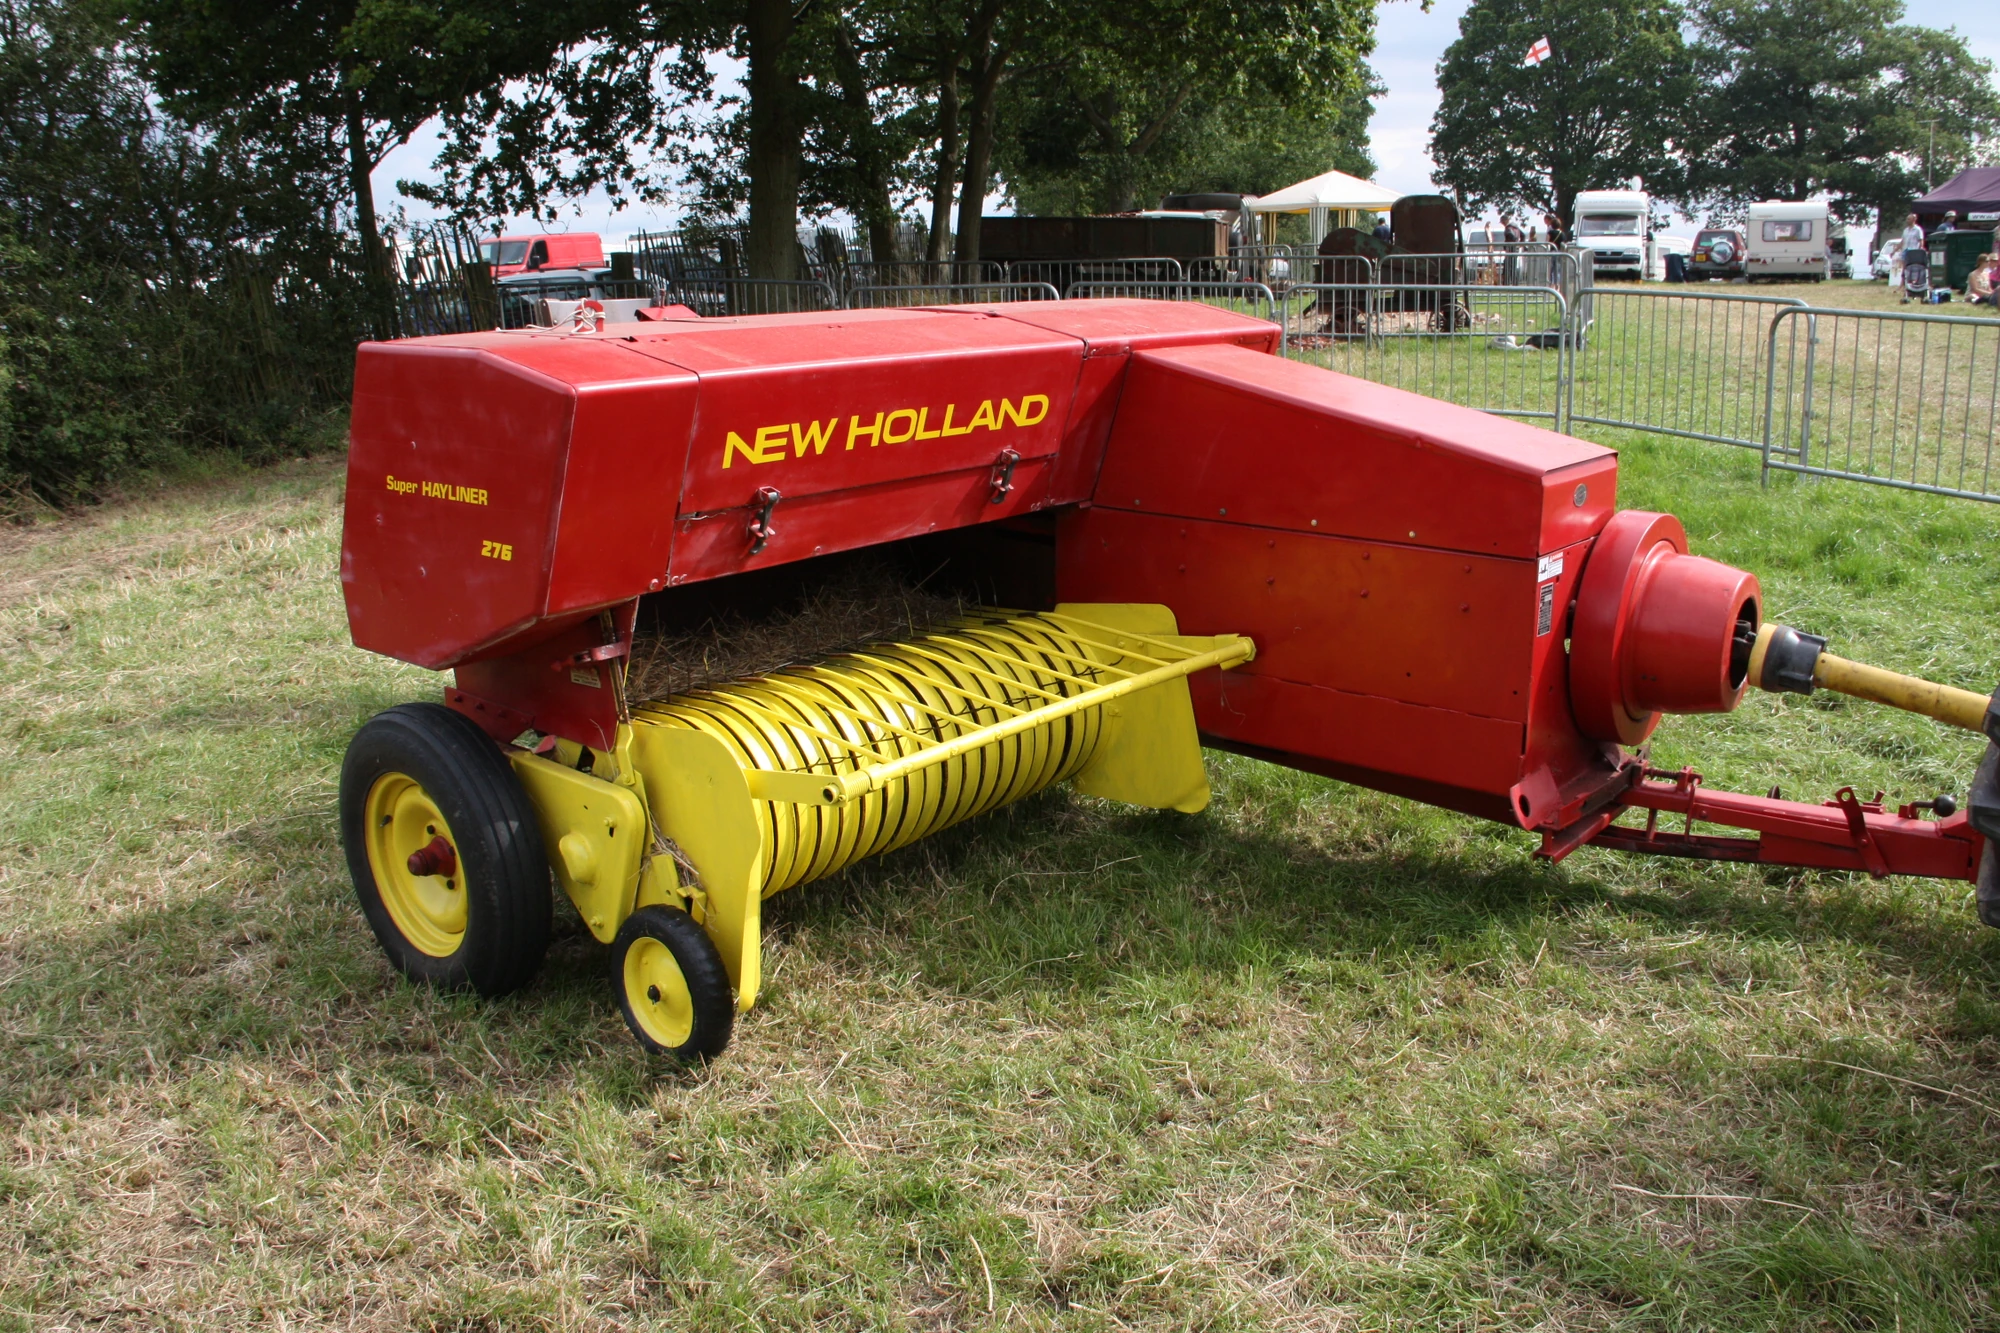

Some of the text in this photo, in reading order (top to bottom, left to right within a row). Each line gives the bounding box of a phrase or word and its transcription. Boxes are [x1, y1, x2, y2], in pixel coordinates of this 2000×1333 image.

[722, 394, 1050, 469] NEW HOLLAND
[386, 475, 488, 506] Super HAYLINER
[481, 540, 513, 561] 276
